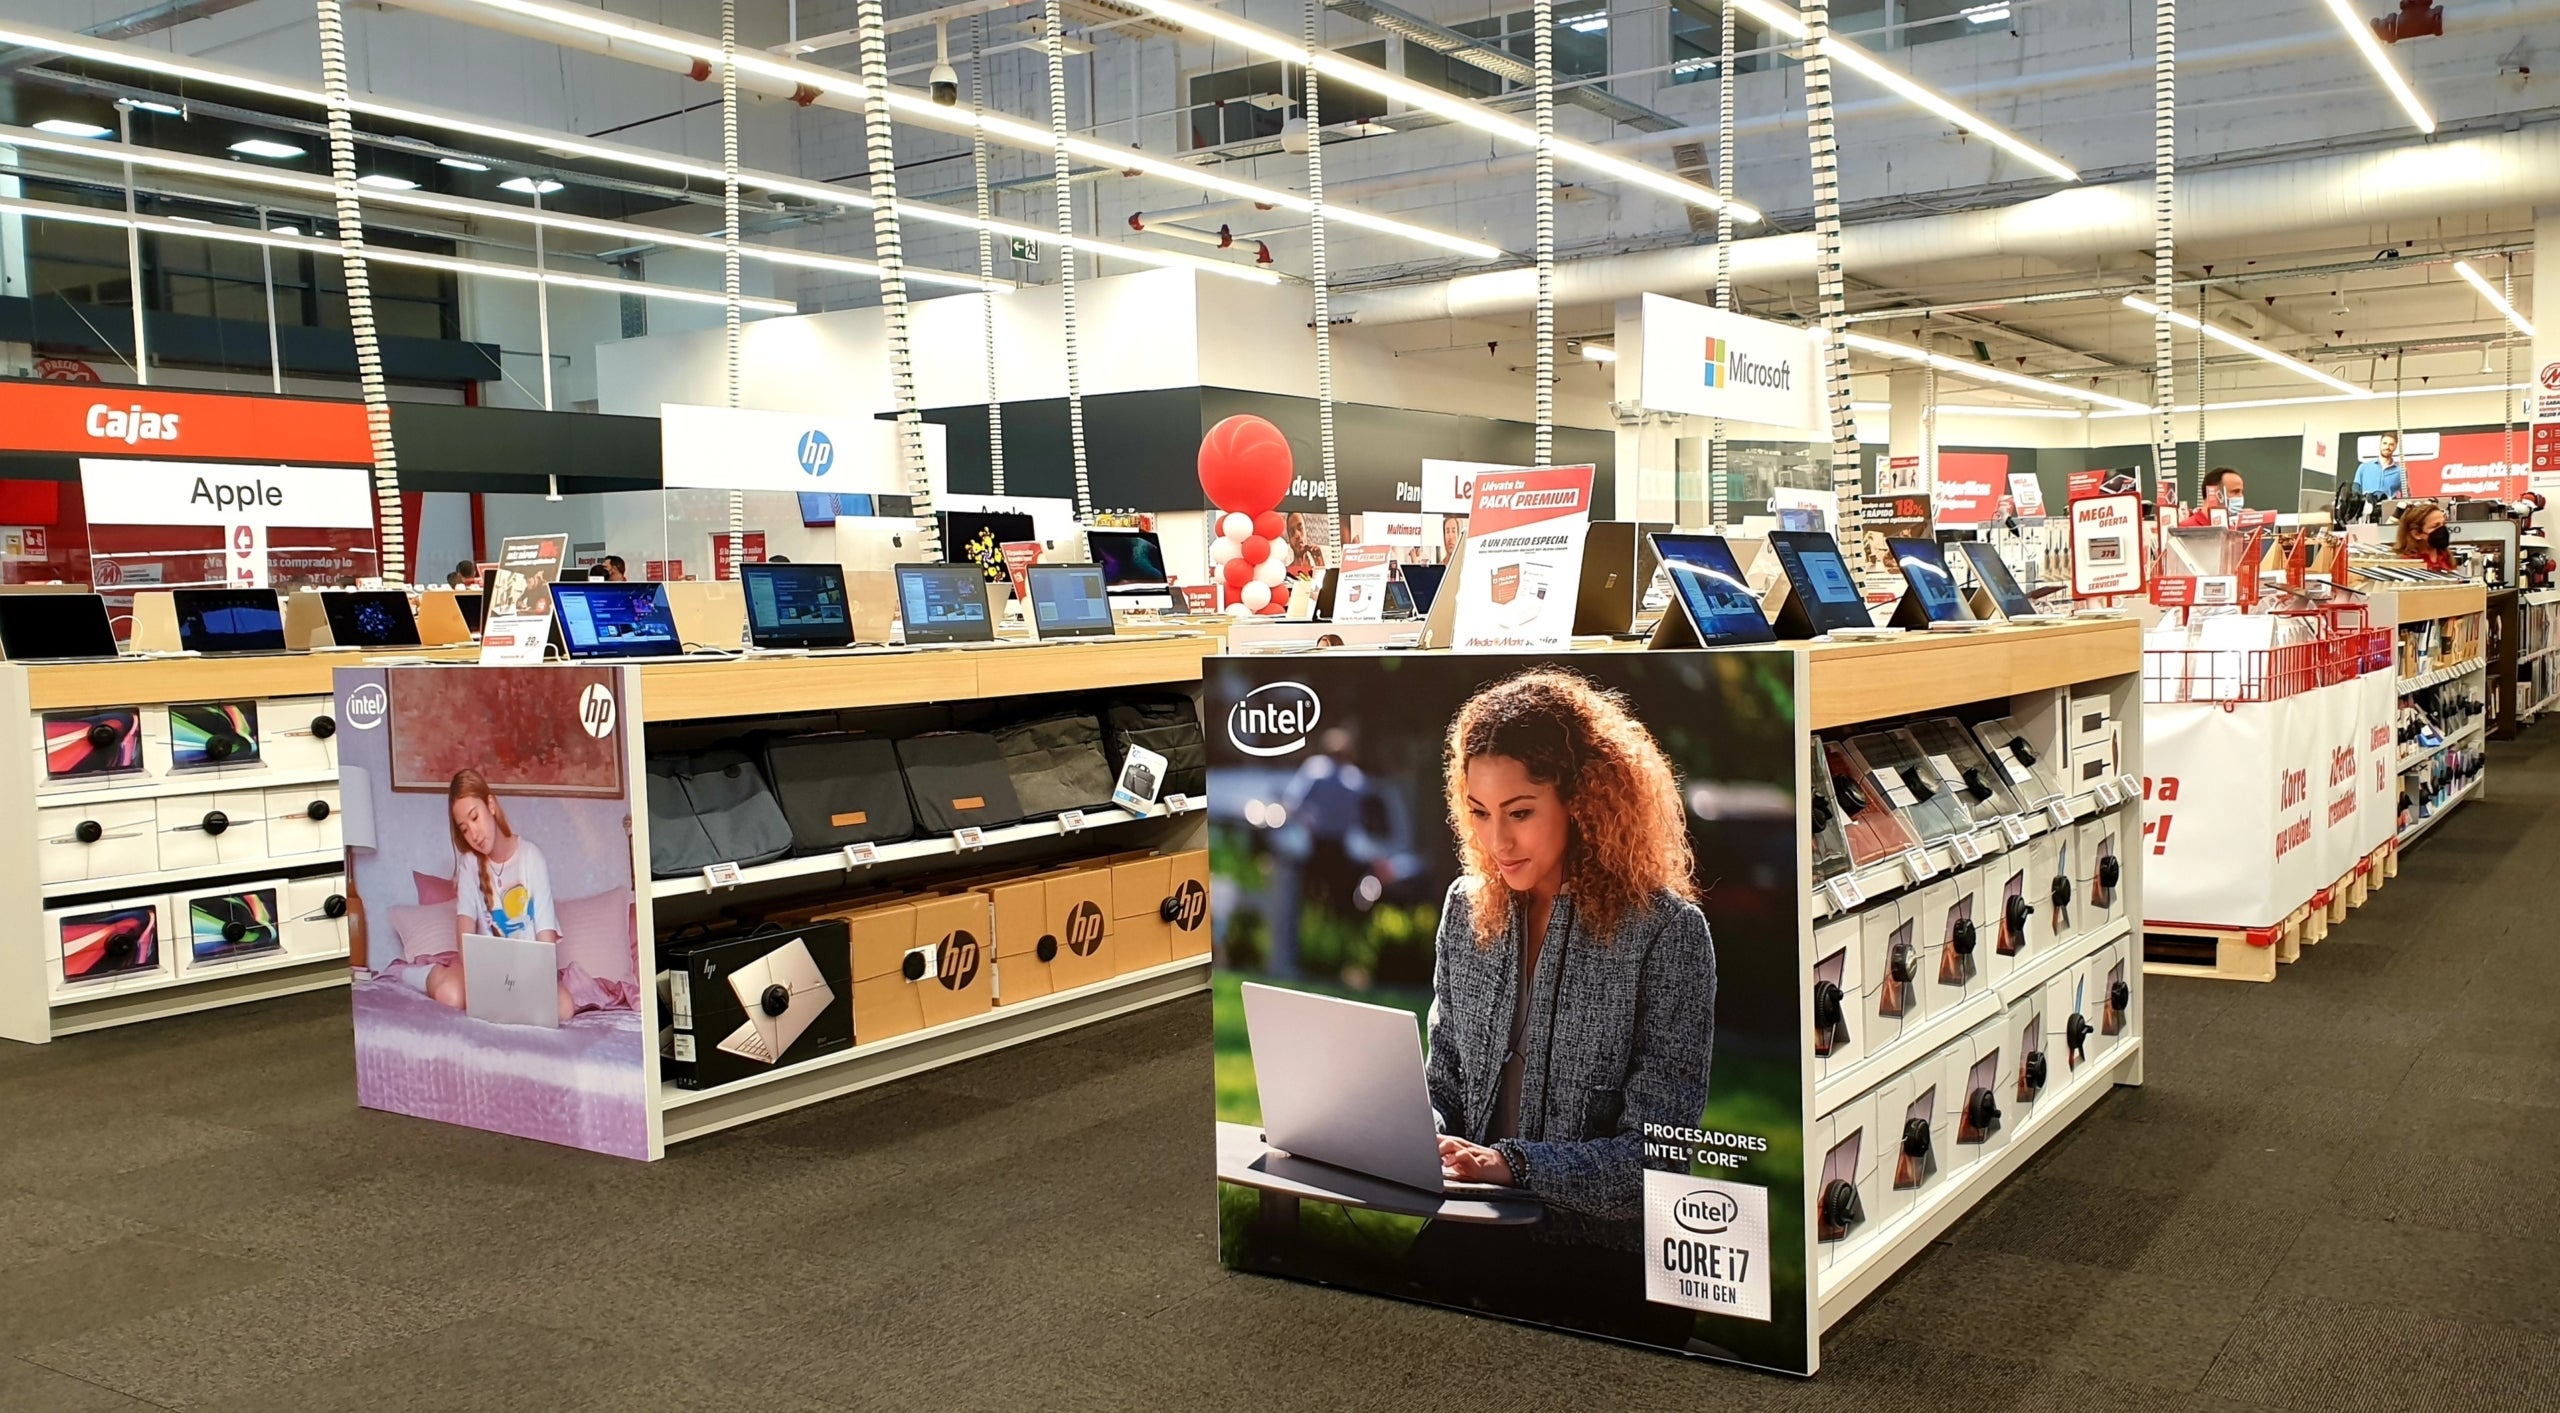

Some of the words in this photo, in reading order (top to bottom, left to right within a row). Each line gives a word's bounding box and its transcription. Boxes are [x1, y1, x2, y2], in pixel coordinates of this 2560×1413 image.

[44, 360, 79, 371] PRECIO
[1729, 351, 1790, 391] Microsoft
[86, 403, 179, 445] Cajas
[799, 429, 834, 476] hp
[191, 477, 283, 511] Apple
[1292, 475, 1307, 497] de
[1479, 494, 1512, 509] PACK
[1515, 492, 1576, 507] PREMIUM
[1866, 508, 1894, 518] RÁPIDO
[1895, 499, 1924, 516] 18%
[2079, 505, 2114, 523] MEGA
[2099, 516, 2128, 528] OFERTA
[1480, 539, 1487, 548] A
[1487, 539, 1500, 548] UN
[1500, 537, 1531, 547] PRECIO
[1531, 535, 1569, 545] ESPECIAL
[279, 557, 331, 569] comprado
[332, 559, 341, 569] y
[342, 557, 353, 567] lo
[351, 694, 382, 715] intel
[584, 683, 612, 738] hp
[1240, 700, 1305, 735] intel
[2158, 776, 2180, 801] a
[2280, 768, 2306, 812] ¡Corre
[1177, 879, 1205, 932] hp
[1068, 901, 1103, 957] hp
[939, 930, 978, 991] hp
[1643, 1122, 1767, 1151] PROCESADORES
[1681, 1197, 1728, 1223] intel
[1663, 1237, 1722, 1280] CORE
[1728, 1247, 1750, 1283] i7
[1679, 1279, 1709, 1299] 10TH
[1713, 1284, 1736, 1304] GEN
